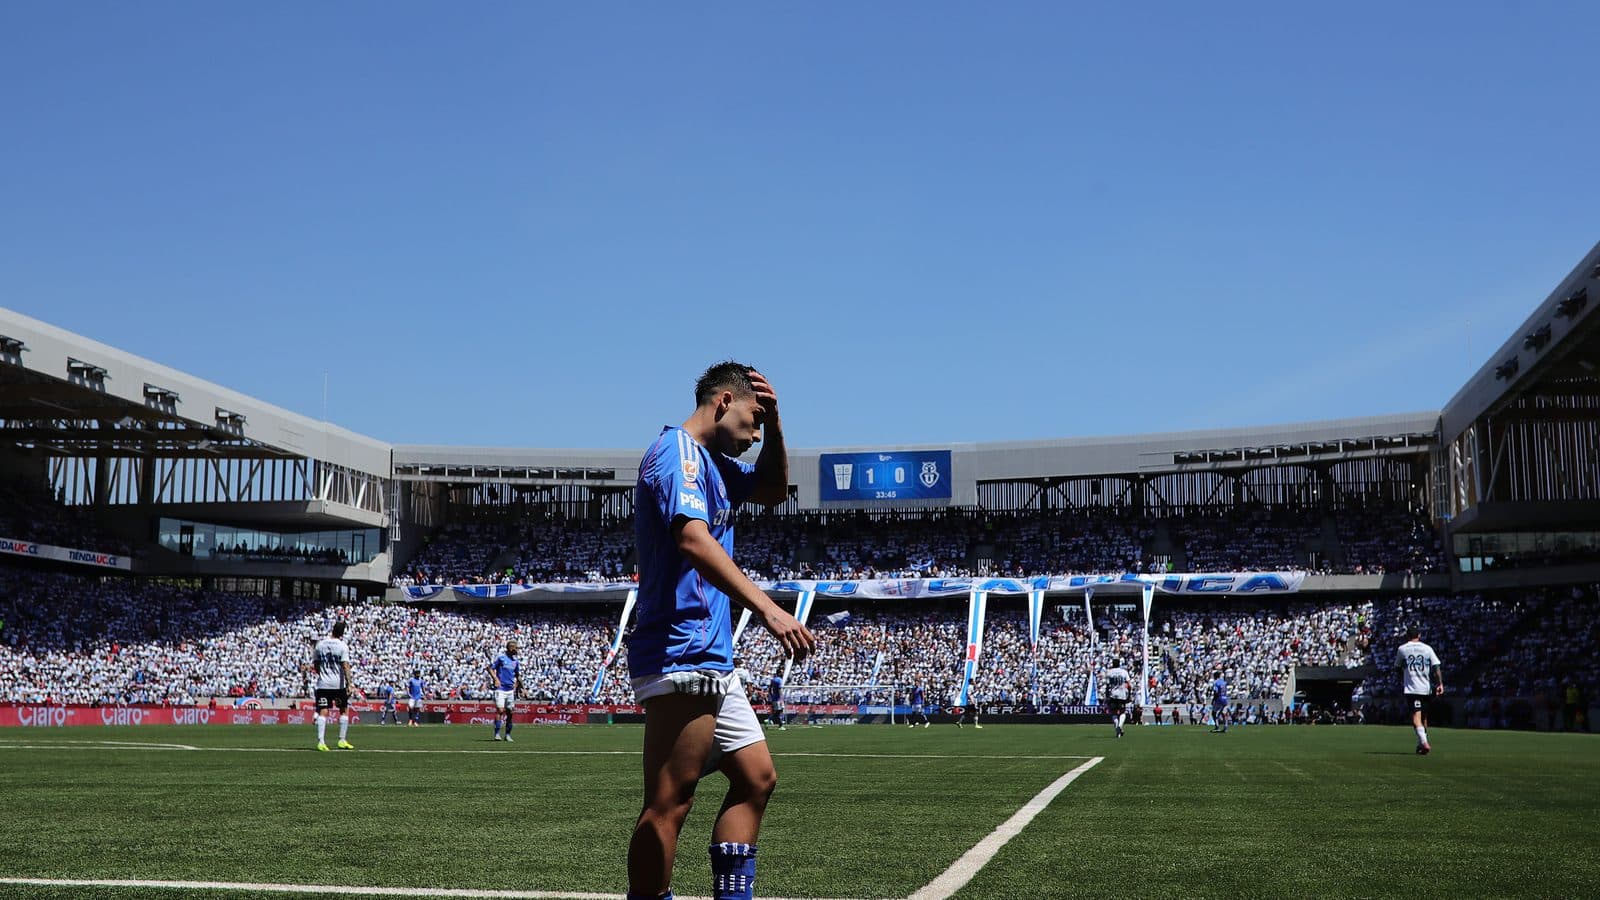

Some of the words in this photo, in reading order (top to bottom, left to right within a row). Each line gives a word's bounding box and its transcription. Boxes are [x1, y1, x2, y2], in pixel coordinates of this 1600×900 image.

[866, 468, 874, 484] 1
[895, 467, 905, 483] 0
[875, 491, 896, 499] 33:45
[0, 540, 38, 555] DAUC.CL
[1408, 654, 1424, 672] 23
[18, 706, 66, 727] Claro
[101, 706, 143, 726] Claro
[172, 706, 209, 725] Claro
[815, 717, 858, 726] SODIMAC
